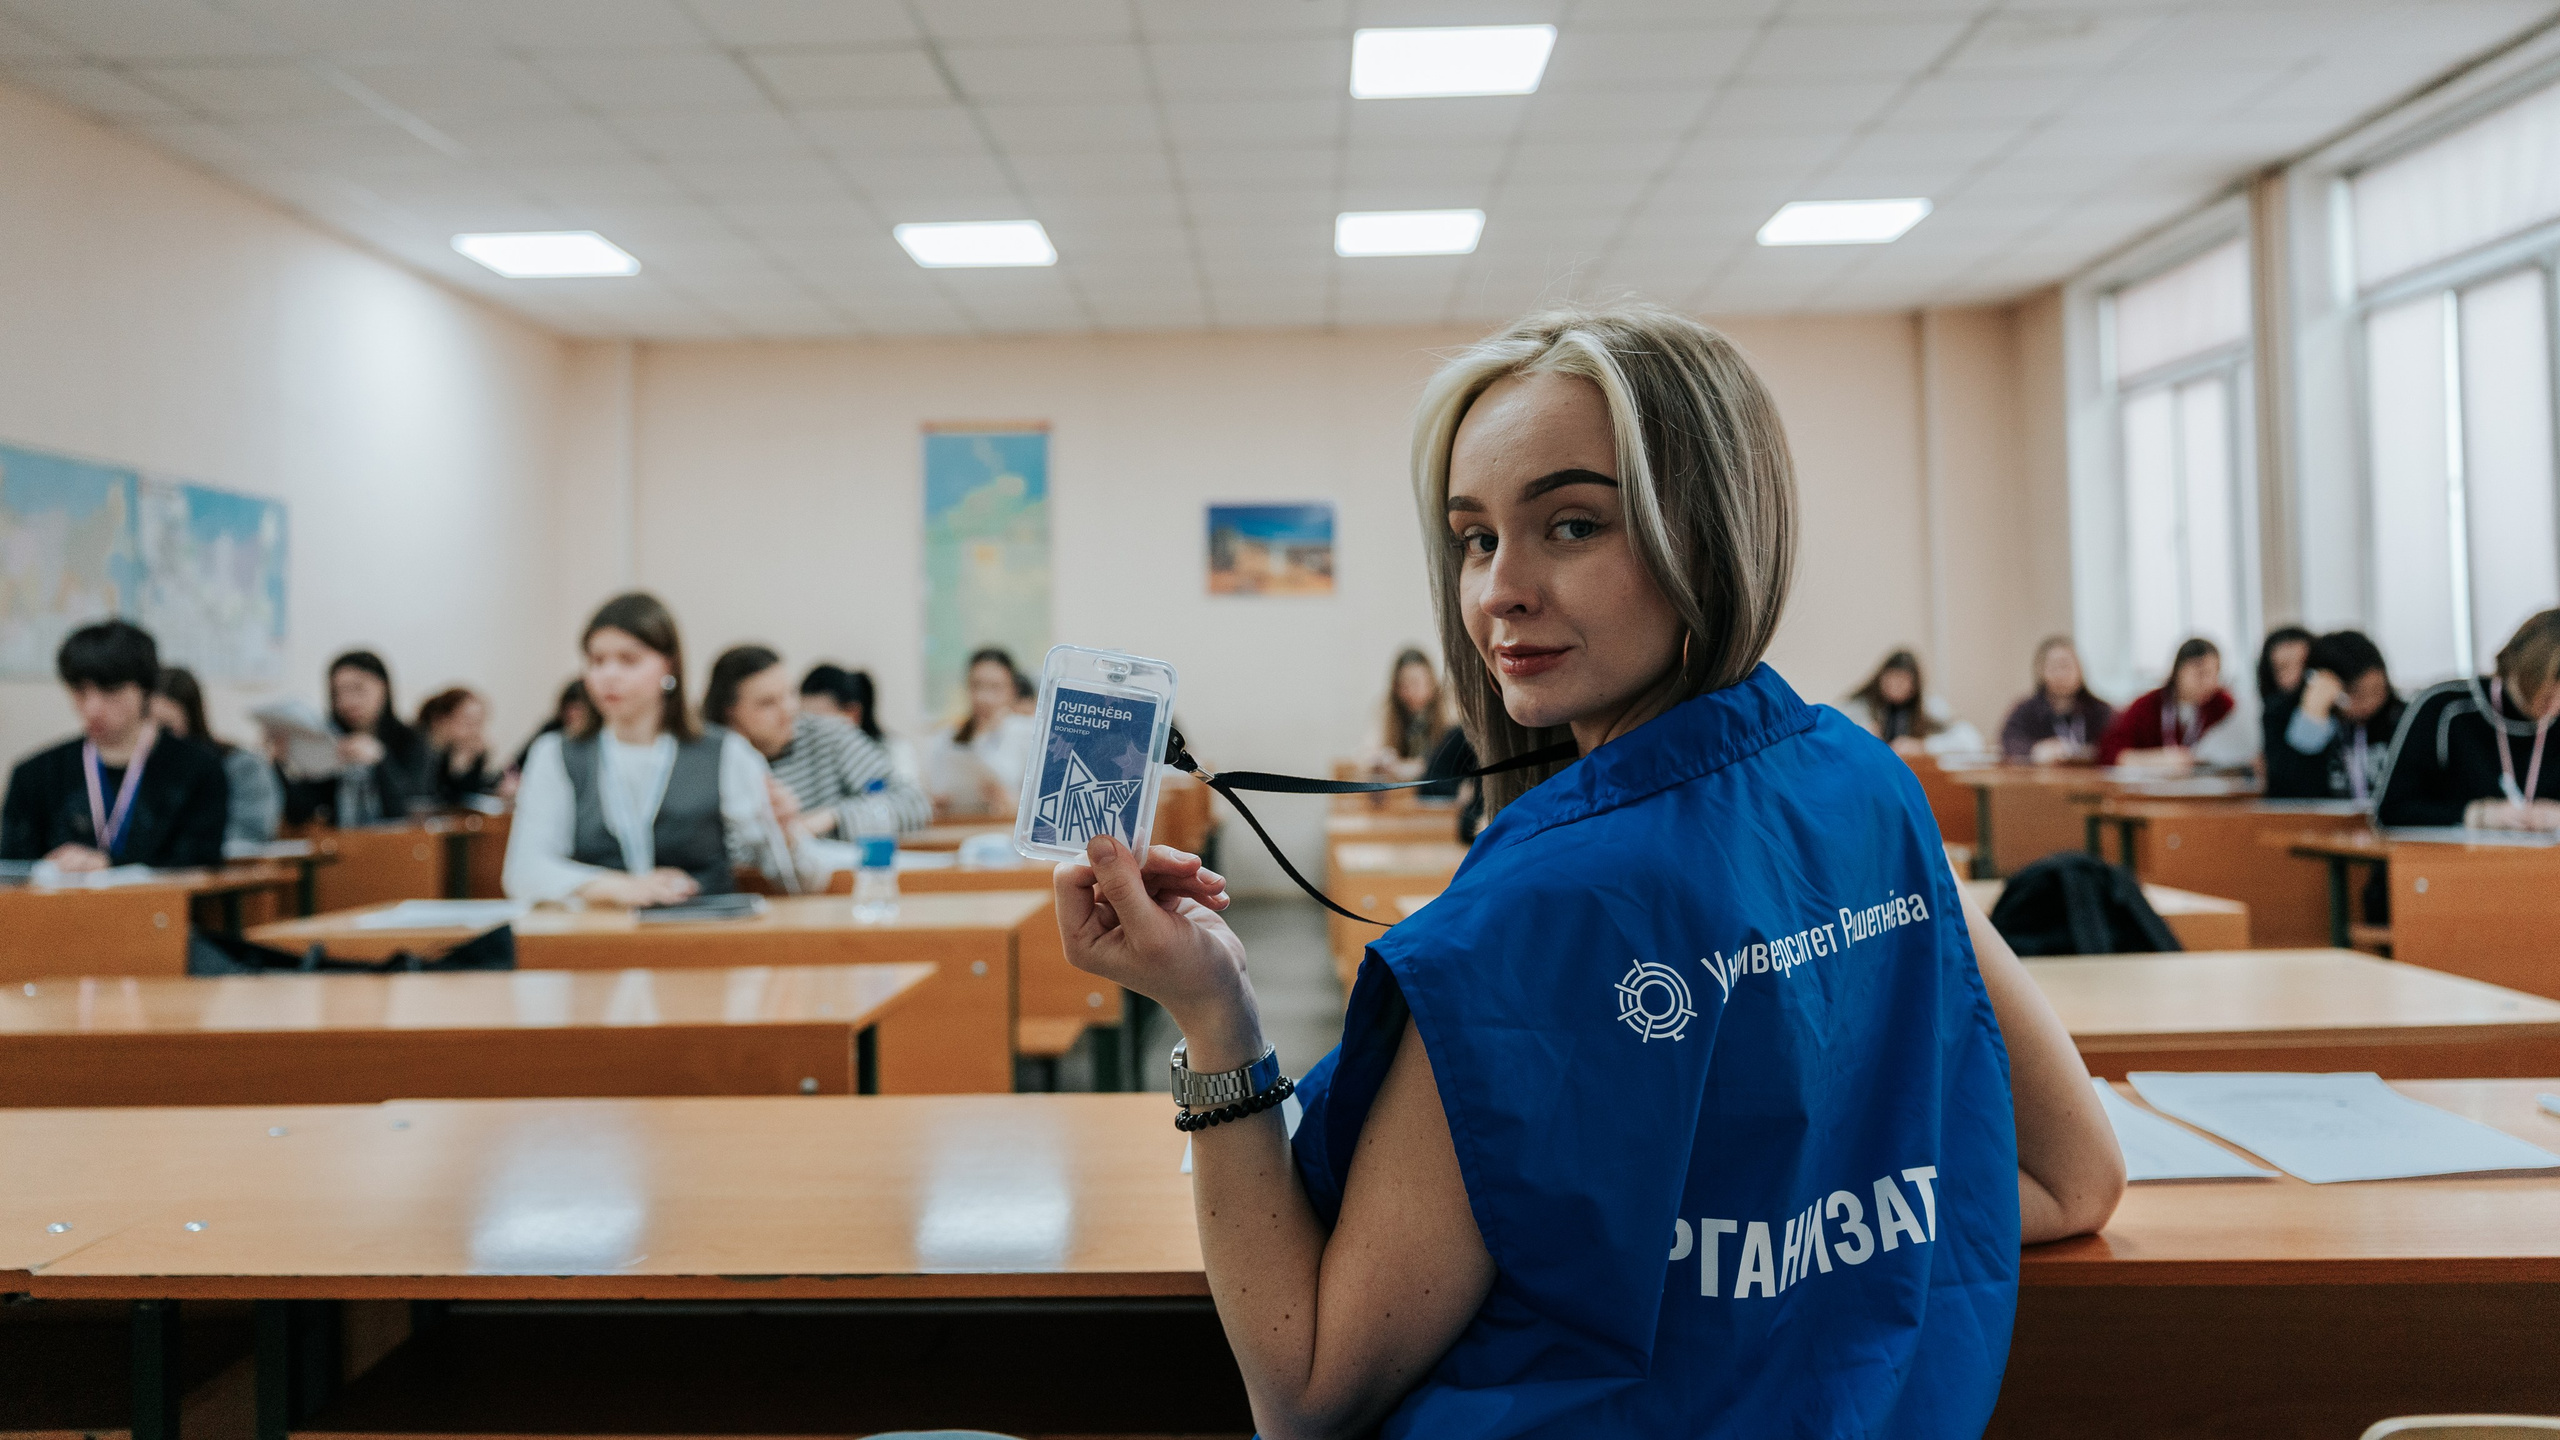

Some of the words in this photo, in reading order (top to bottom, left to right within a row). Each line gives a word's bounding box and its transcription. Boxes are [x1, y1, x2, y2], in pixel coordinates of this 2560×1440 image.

[1058, 701, 1132, 721] ЛУПАЧЁВА
[1054, 725, 1090, 736] ВОЛОНТЕР
[1056, 713, 1110, 730] КСЕНИЯ
[1700, 923, 1838, 1004] Университет
